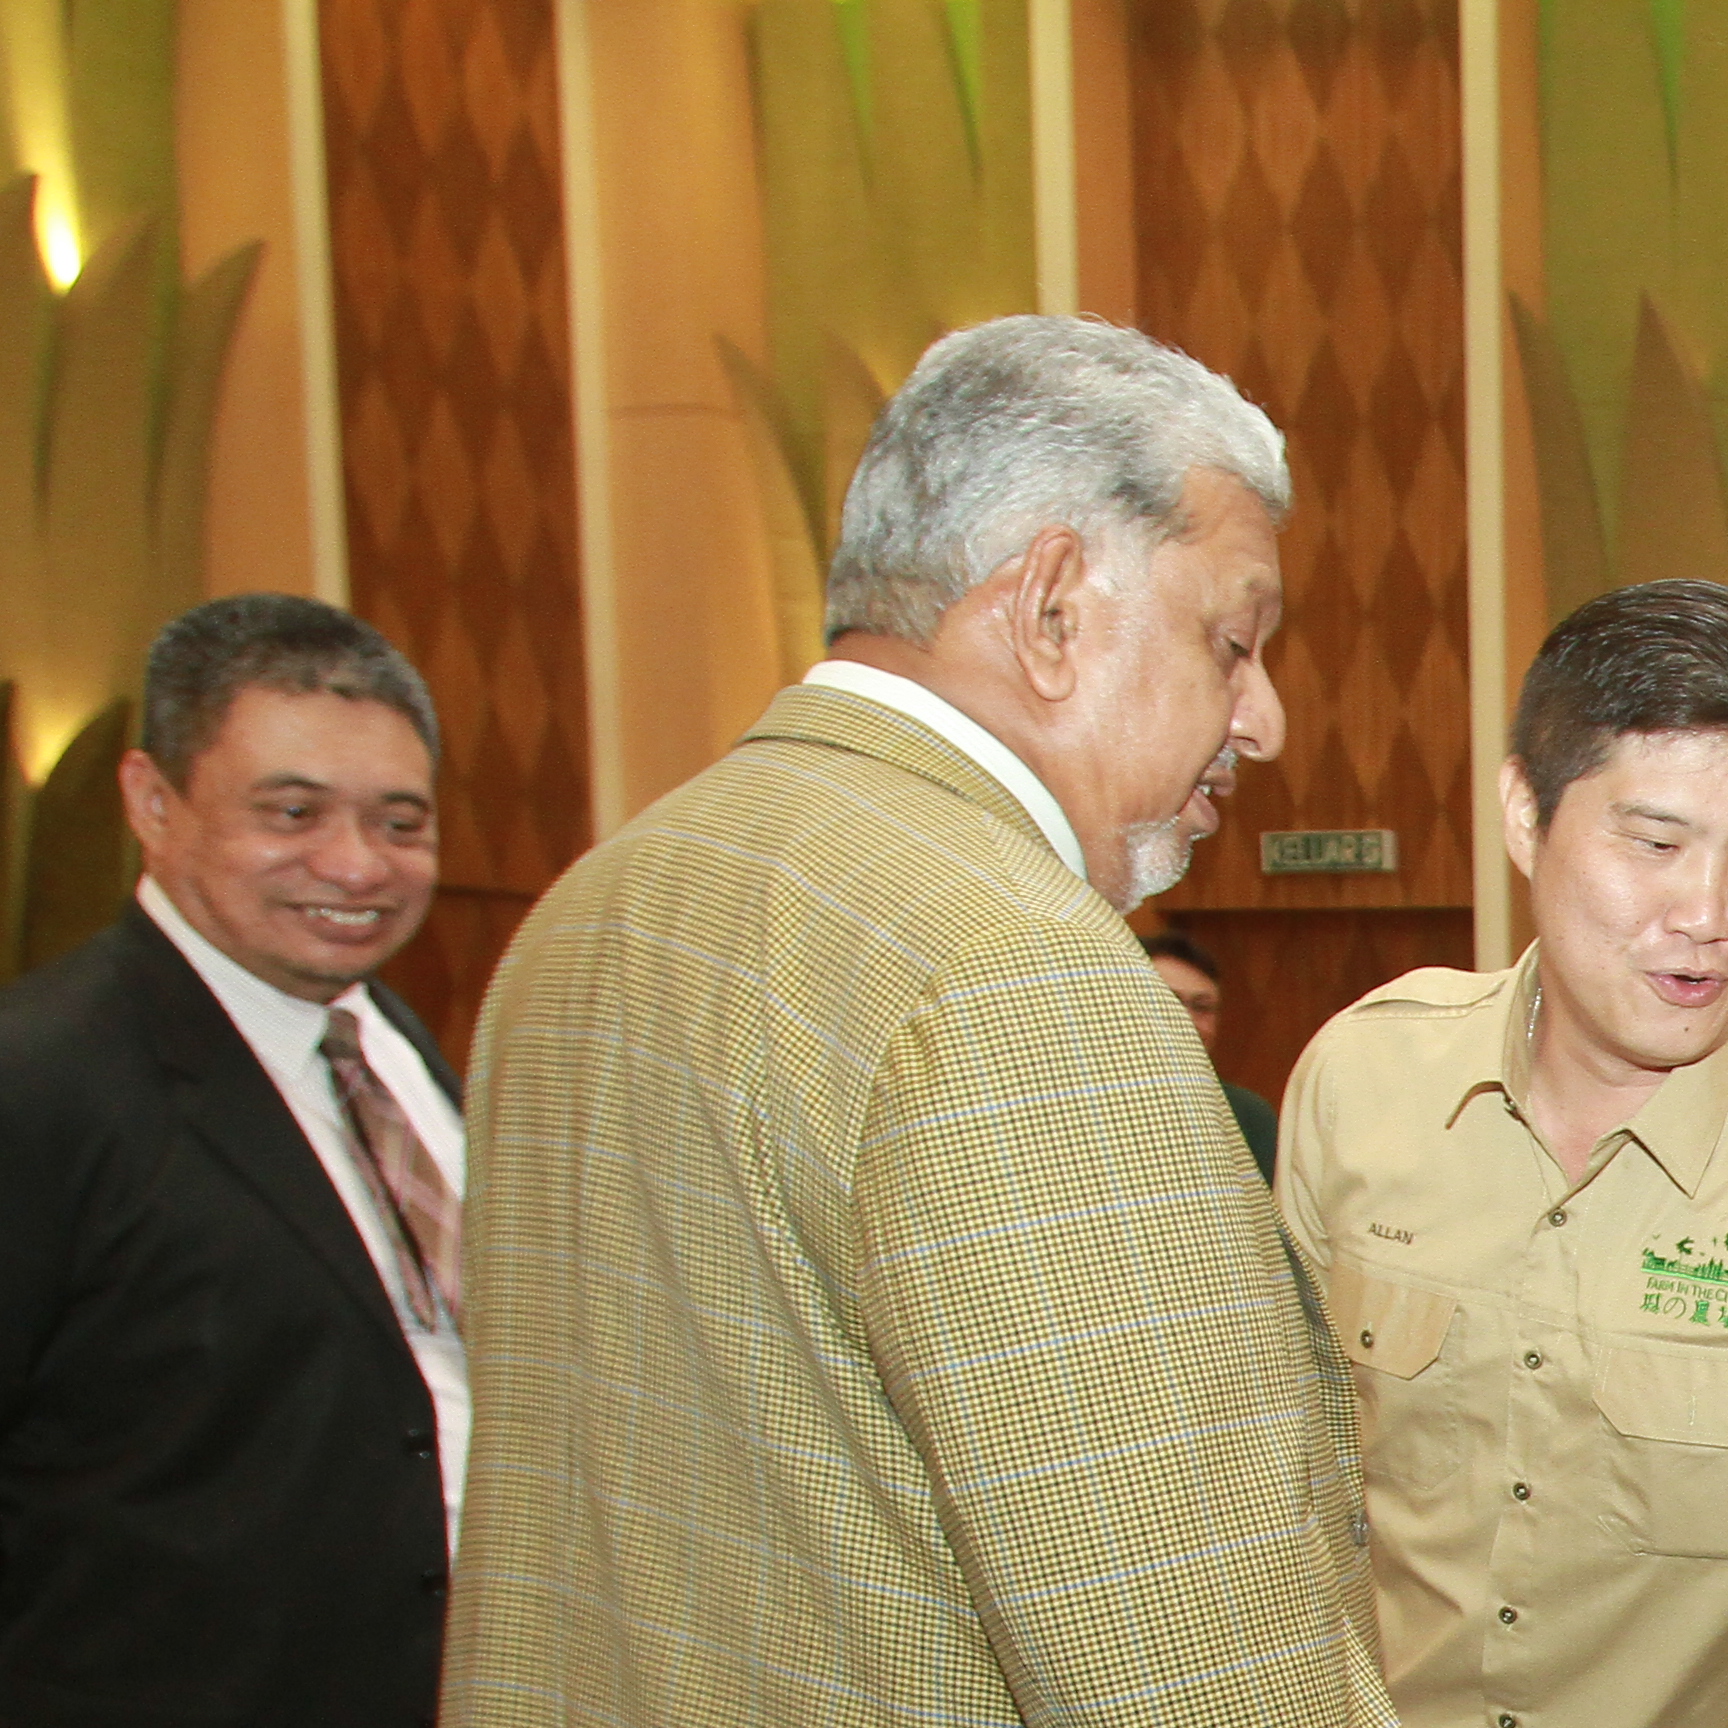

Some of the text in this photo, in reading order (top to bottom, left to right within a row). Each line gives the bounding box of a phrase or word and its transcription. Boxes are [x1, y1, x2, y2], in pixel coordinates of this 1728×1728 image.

[1368, 1222, 1415, 1245] ALLAN
[1646, 1276, 1674, 1293] FARM
[1692, 1284, 1714, 1300] THE
